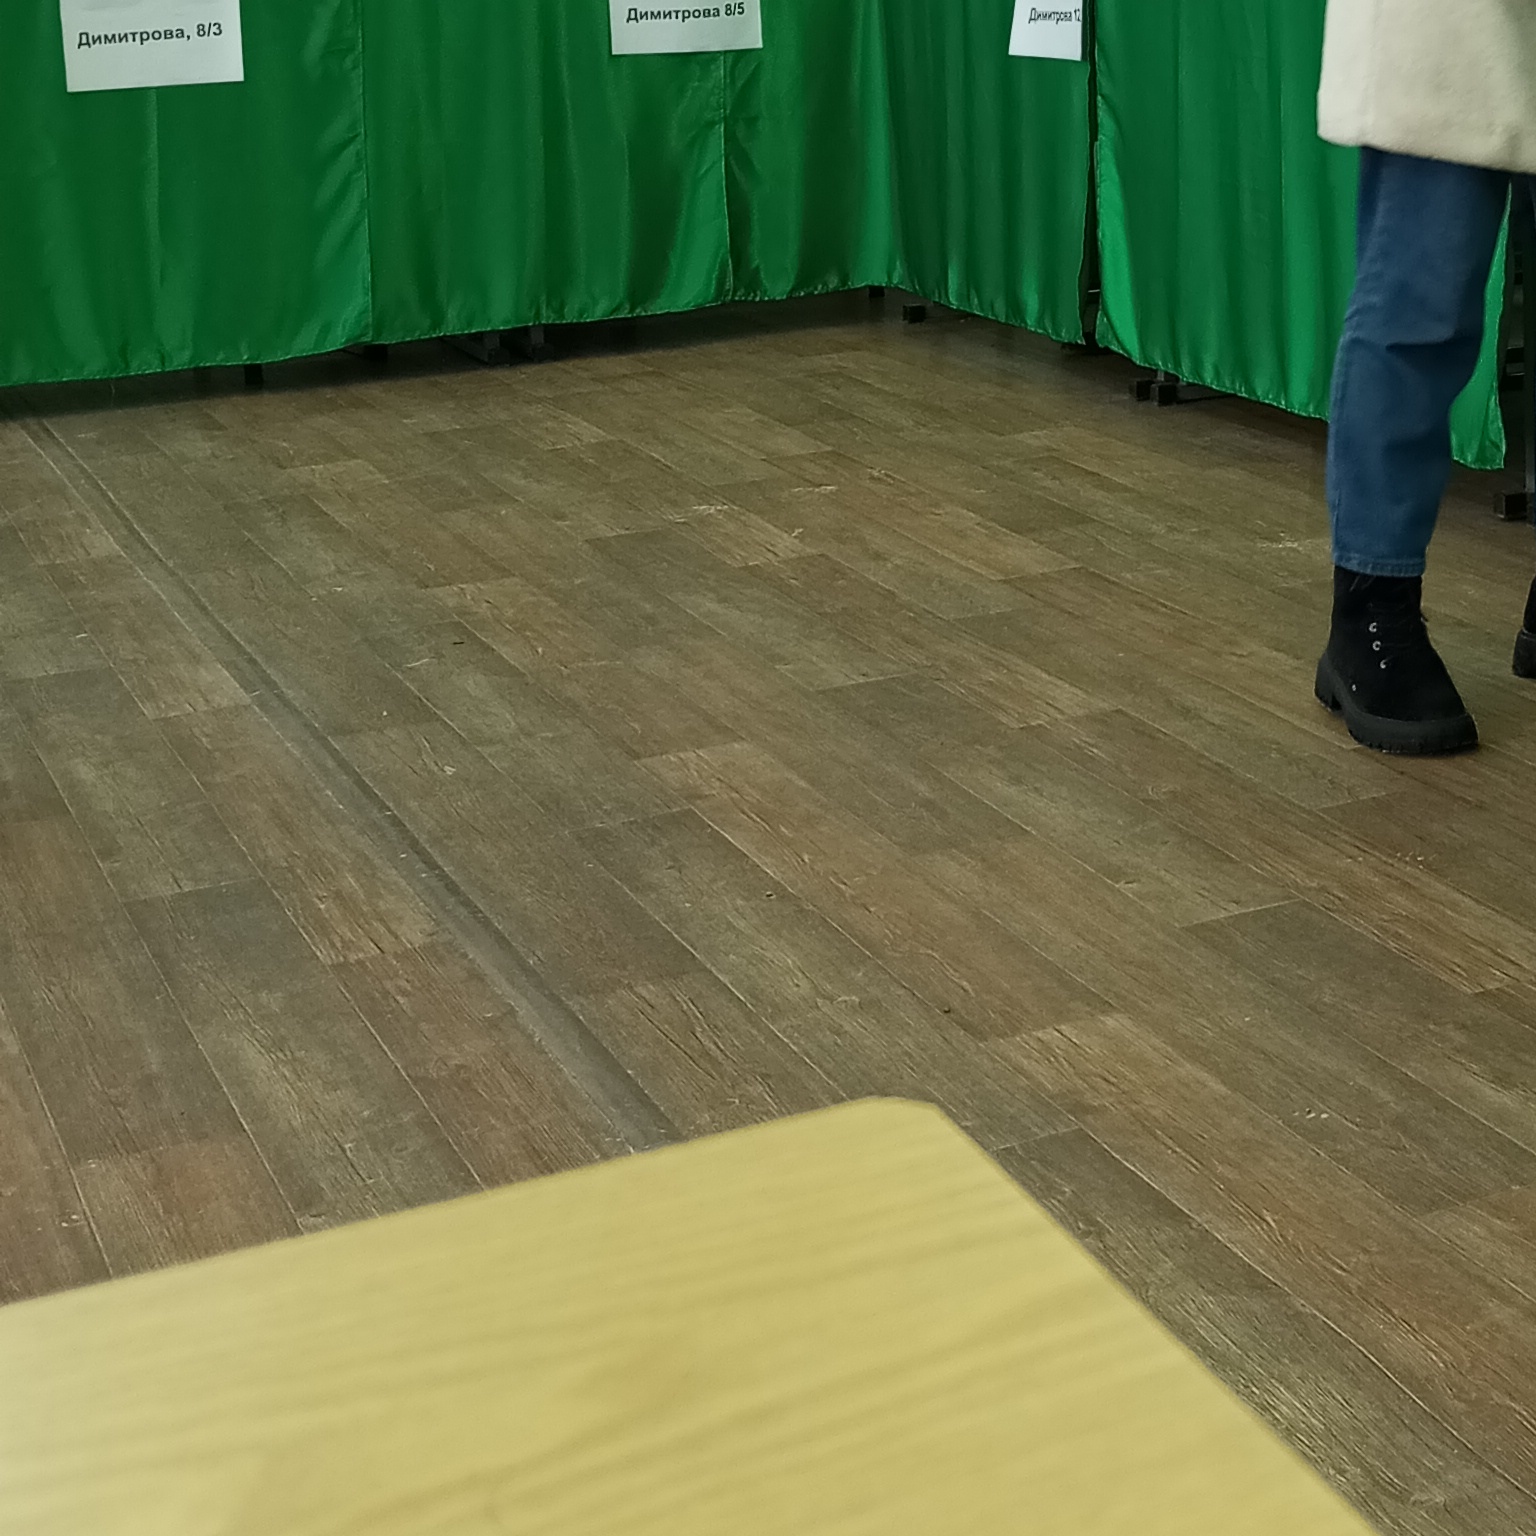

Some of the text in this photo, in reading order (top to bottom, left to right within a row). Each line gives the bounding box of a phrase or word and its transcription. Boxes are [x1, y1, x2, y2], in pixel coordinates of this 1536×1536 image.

[626, 2, 745, 23] Димитрова 8/5
[1028, 7, 1073, 24] Димитрова
[77, 22, 223, 50] Димитрова, 8/3
